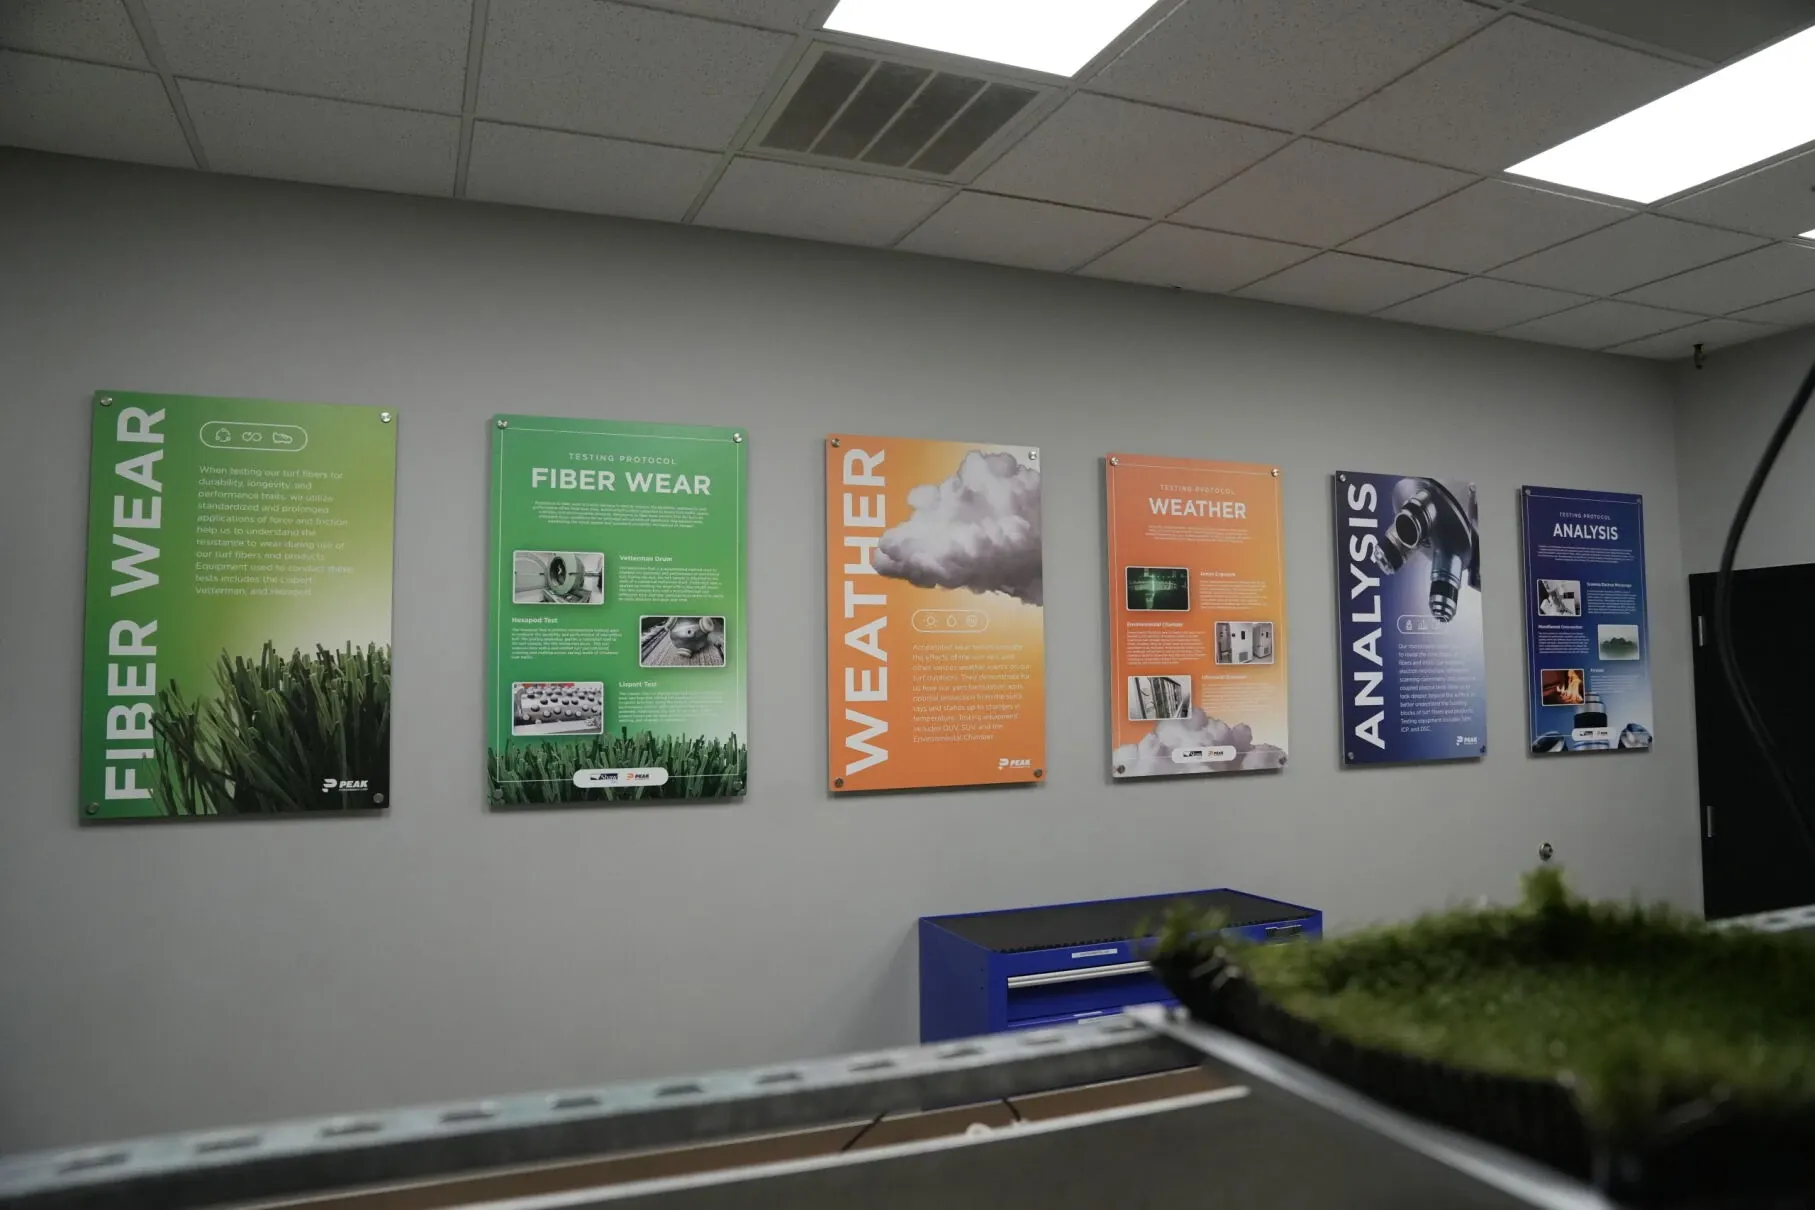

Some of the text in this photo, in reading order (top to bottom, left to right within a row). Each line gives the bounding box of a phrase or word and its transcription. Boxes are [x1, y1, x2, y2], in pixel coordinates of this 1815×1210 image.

[569, 452, 676, 465] TESTING PROTOCOL
[200, 466, 227, 474] When
[231, 467, 262, 477] testing
[302, 470, 327, 479] fibers
[532, 468, 711, 495] FIBER WEAR
[198, 490, 258, 500] performance
[1160, 484, 1235, 495] TESTING PROTOCOL
[198, 502, 258, 511] standardized
[282, 505, 329, 514] prolonged
[1148, 497, 1247, 519] WEATHER
[197, 515, 255, 524] applications
[257, 515, 268, 523] of
[269, 516, 293, 524] force
[196, 526, 217, 535] help
[1553, 523, 1619, 540] ANALYSIS
[285, 540, 314, 550] during
[195, 562, 248, 571] Equipment
[104, 406, 166, 800] FIBER WEAR
[843, 448, 888, 776] WEATHER
[1348, 482, 1385, 750] ANALYSIS
[339, 780, 368, 788] PEAK
